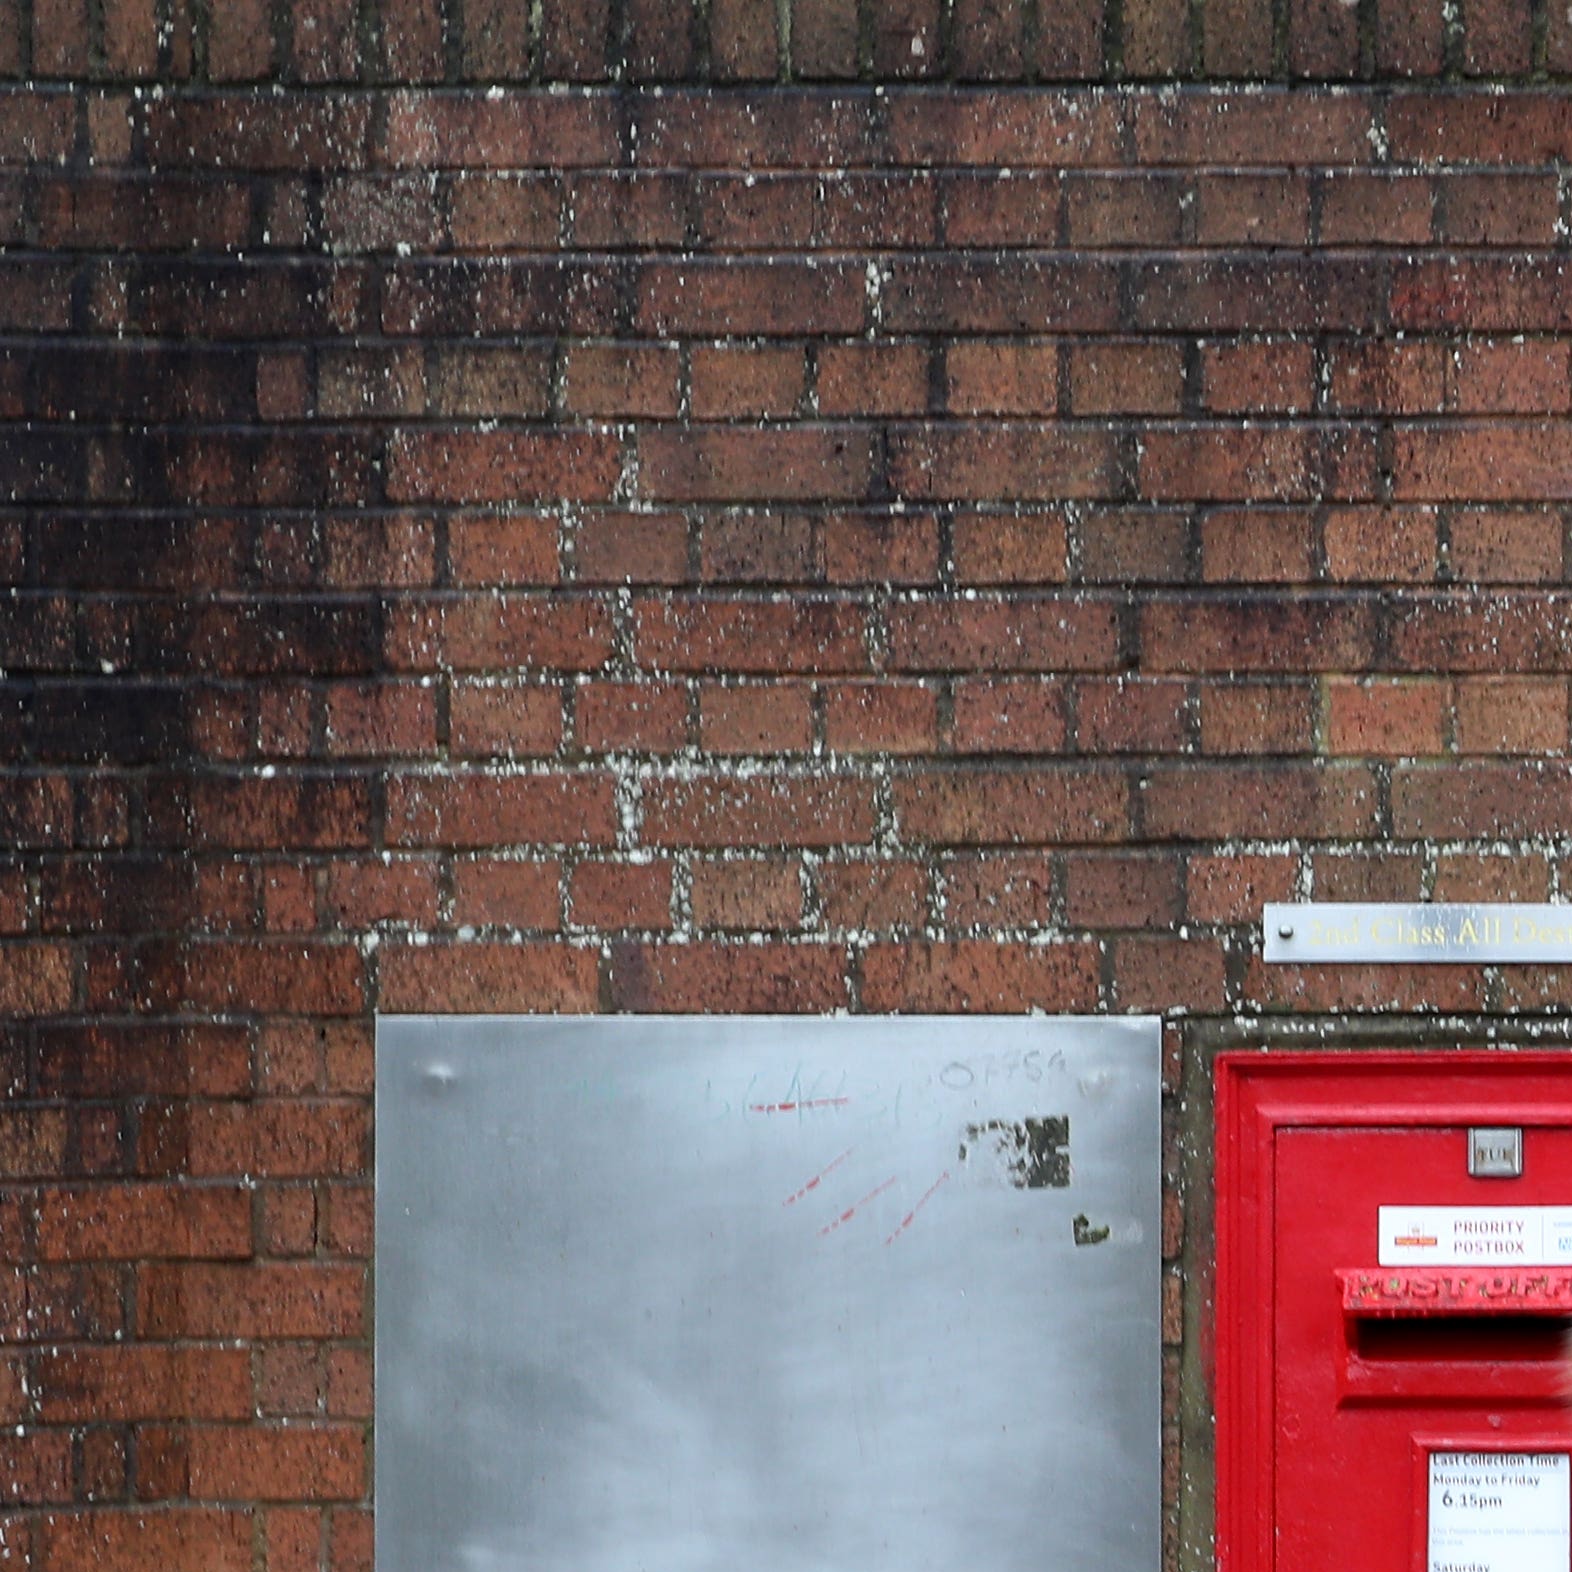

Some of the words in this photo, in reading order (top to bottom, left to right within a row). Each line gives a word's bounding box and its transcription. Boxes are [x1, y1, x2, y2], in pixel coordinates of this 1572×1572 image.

[1310, 919, 1358, 945] 2nd
[1371, 918, 1444, 945] Class
[1457, 919, 1499, 945] All
[1454, 1220, 1525, 1234] PRIORITY
[1454, 1240, 1525, 1254] POSTBOX
[1352, 1275, 1460, 1298] POST
[1433, 1453, 1460, 1467] Last
[1463, 1454, 1525, 1467] Collection
[1528, 1454, 1560, 1467] Time
[1433, 1474, 1481, 1487] Monday
[1485, 1475, 1498, 1485] to
[1501, 1474, 1540, 1487] Friday
